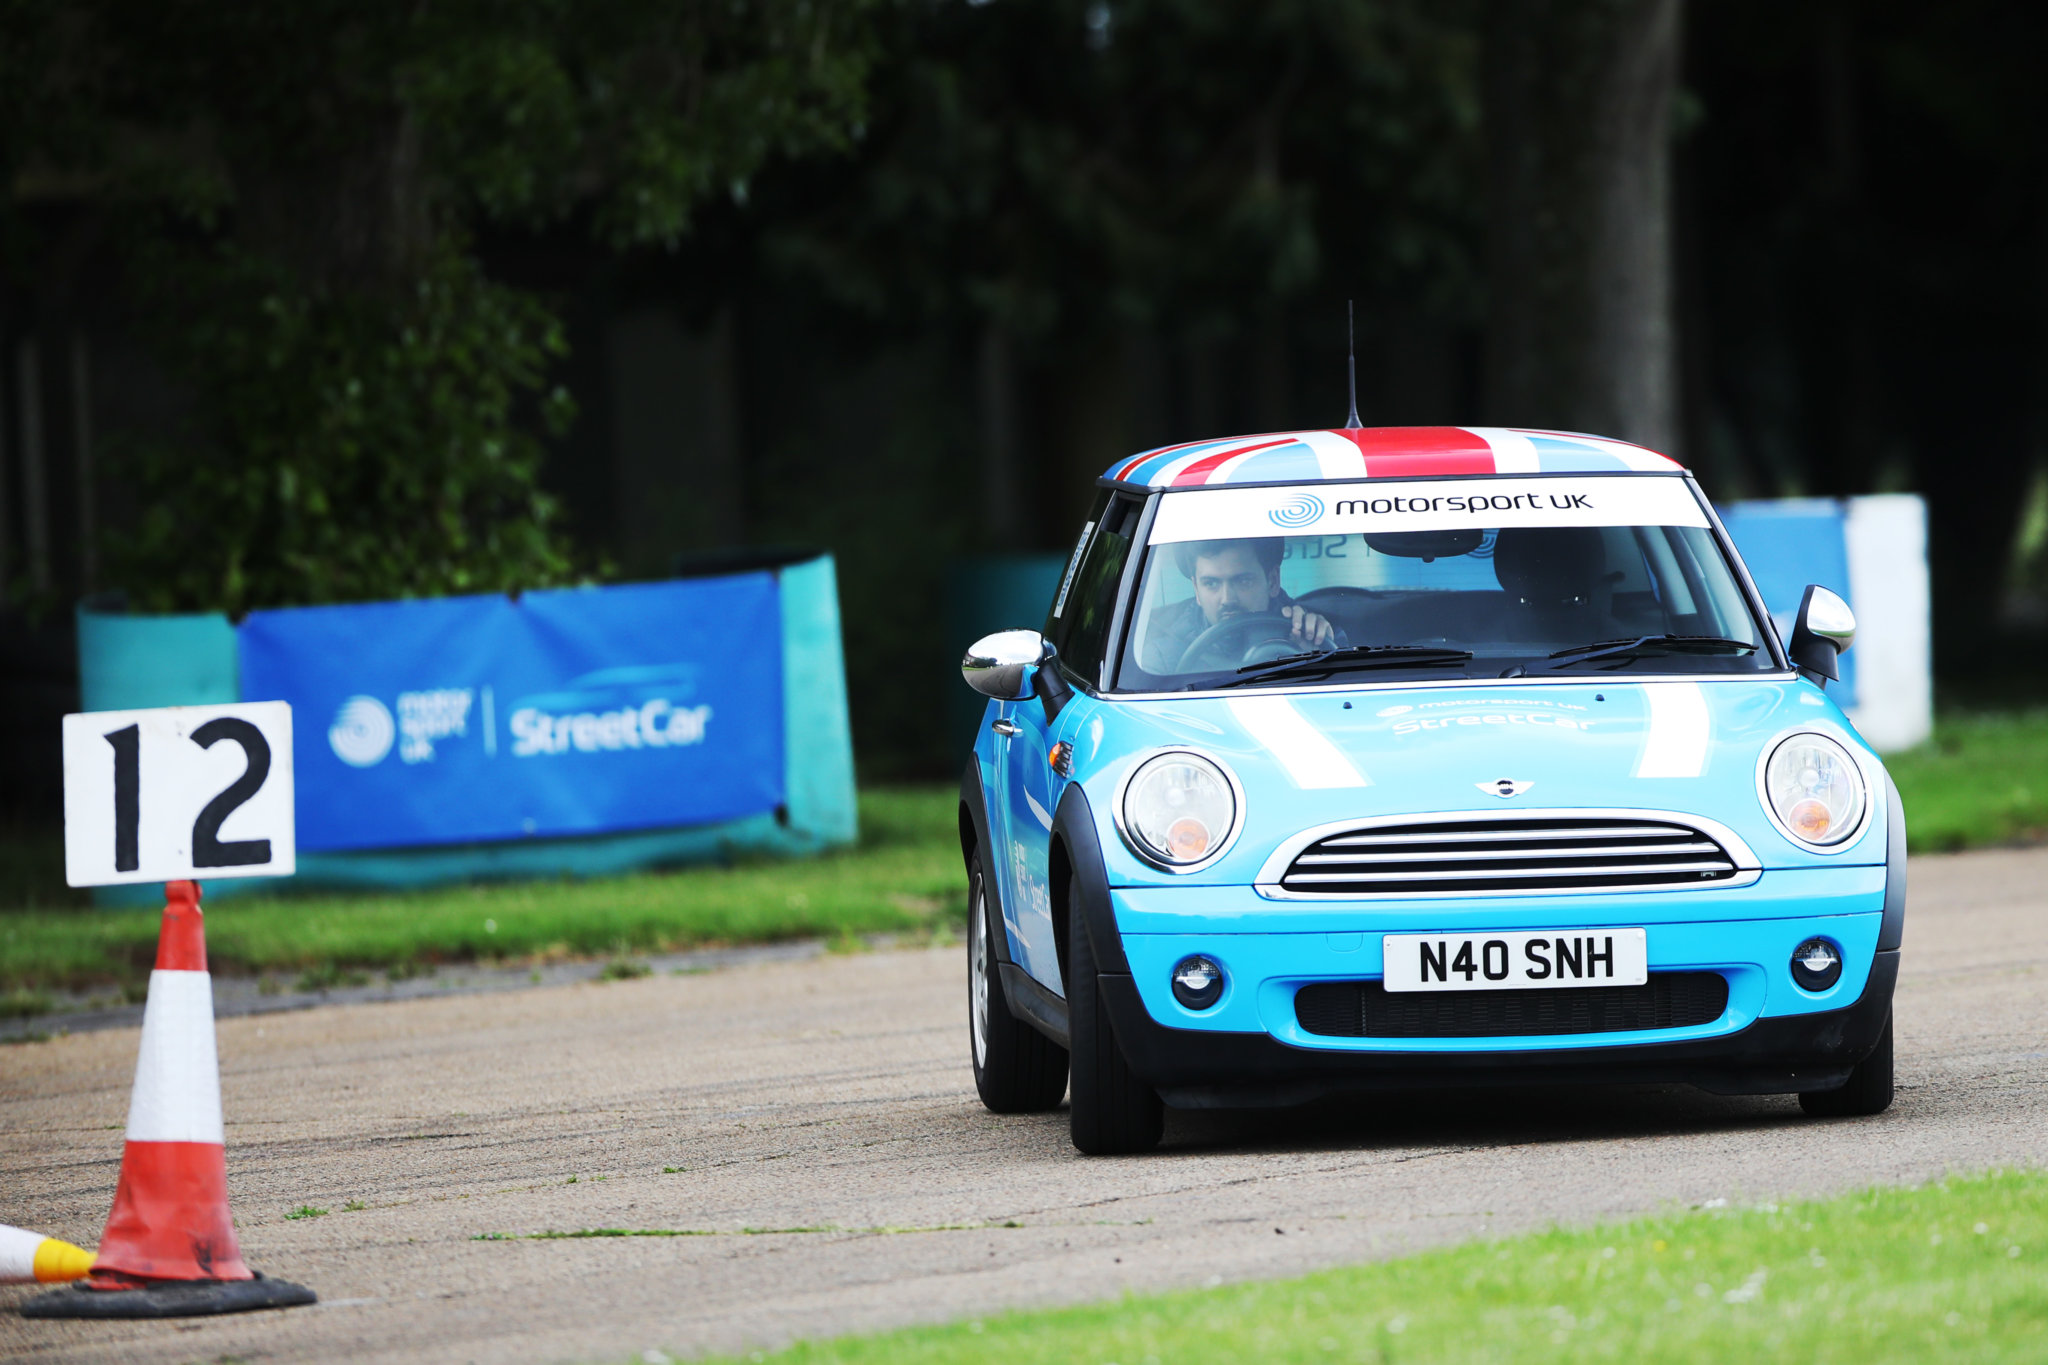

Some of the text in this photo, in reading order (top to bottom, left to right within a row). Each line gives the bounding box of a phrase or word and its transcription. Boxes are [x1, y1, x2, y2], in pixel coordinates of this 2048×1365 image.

[1336, 492, 1543, 515] motorsport
[1418, 698, 1553, 710] motorsport
[510, 698, 713, 757] StreetCar
[1391, 713, 1597, 735] StreetCar
[103, 716, 272, 873] 12
[1420, 936, 1613, 982] N40 SNH
